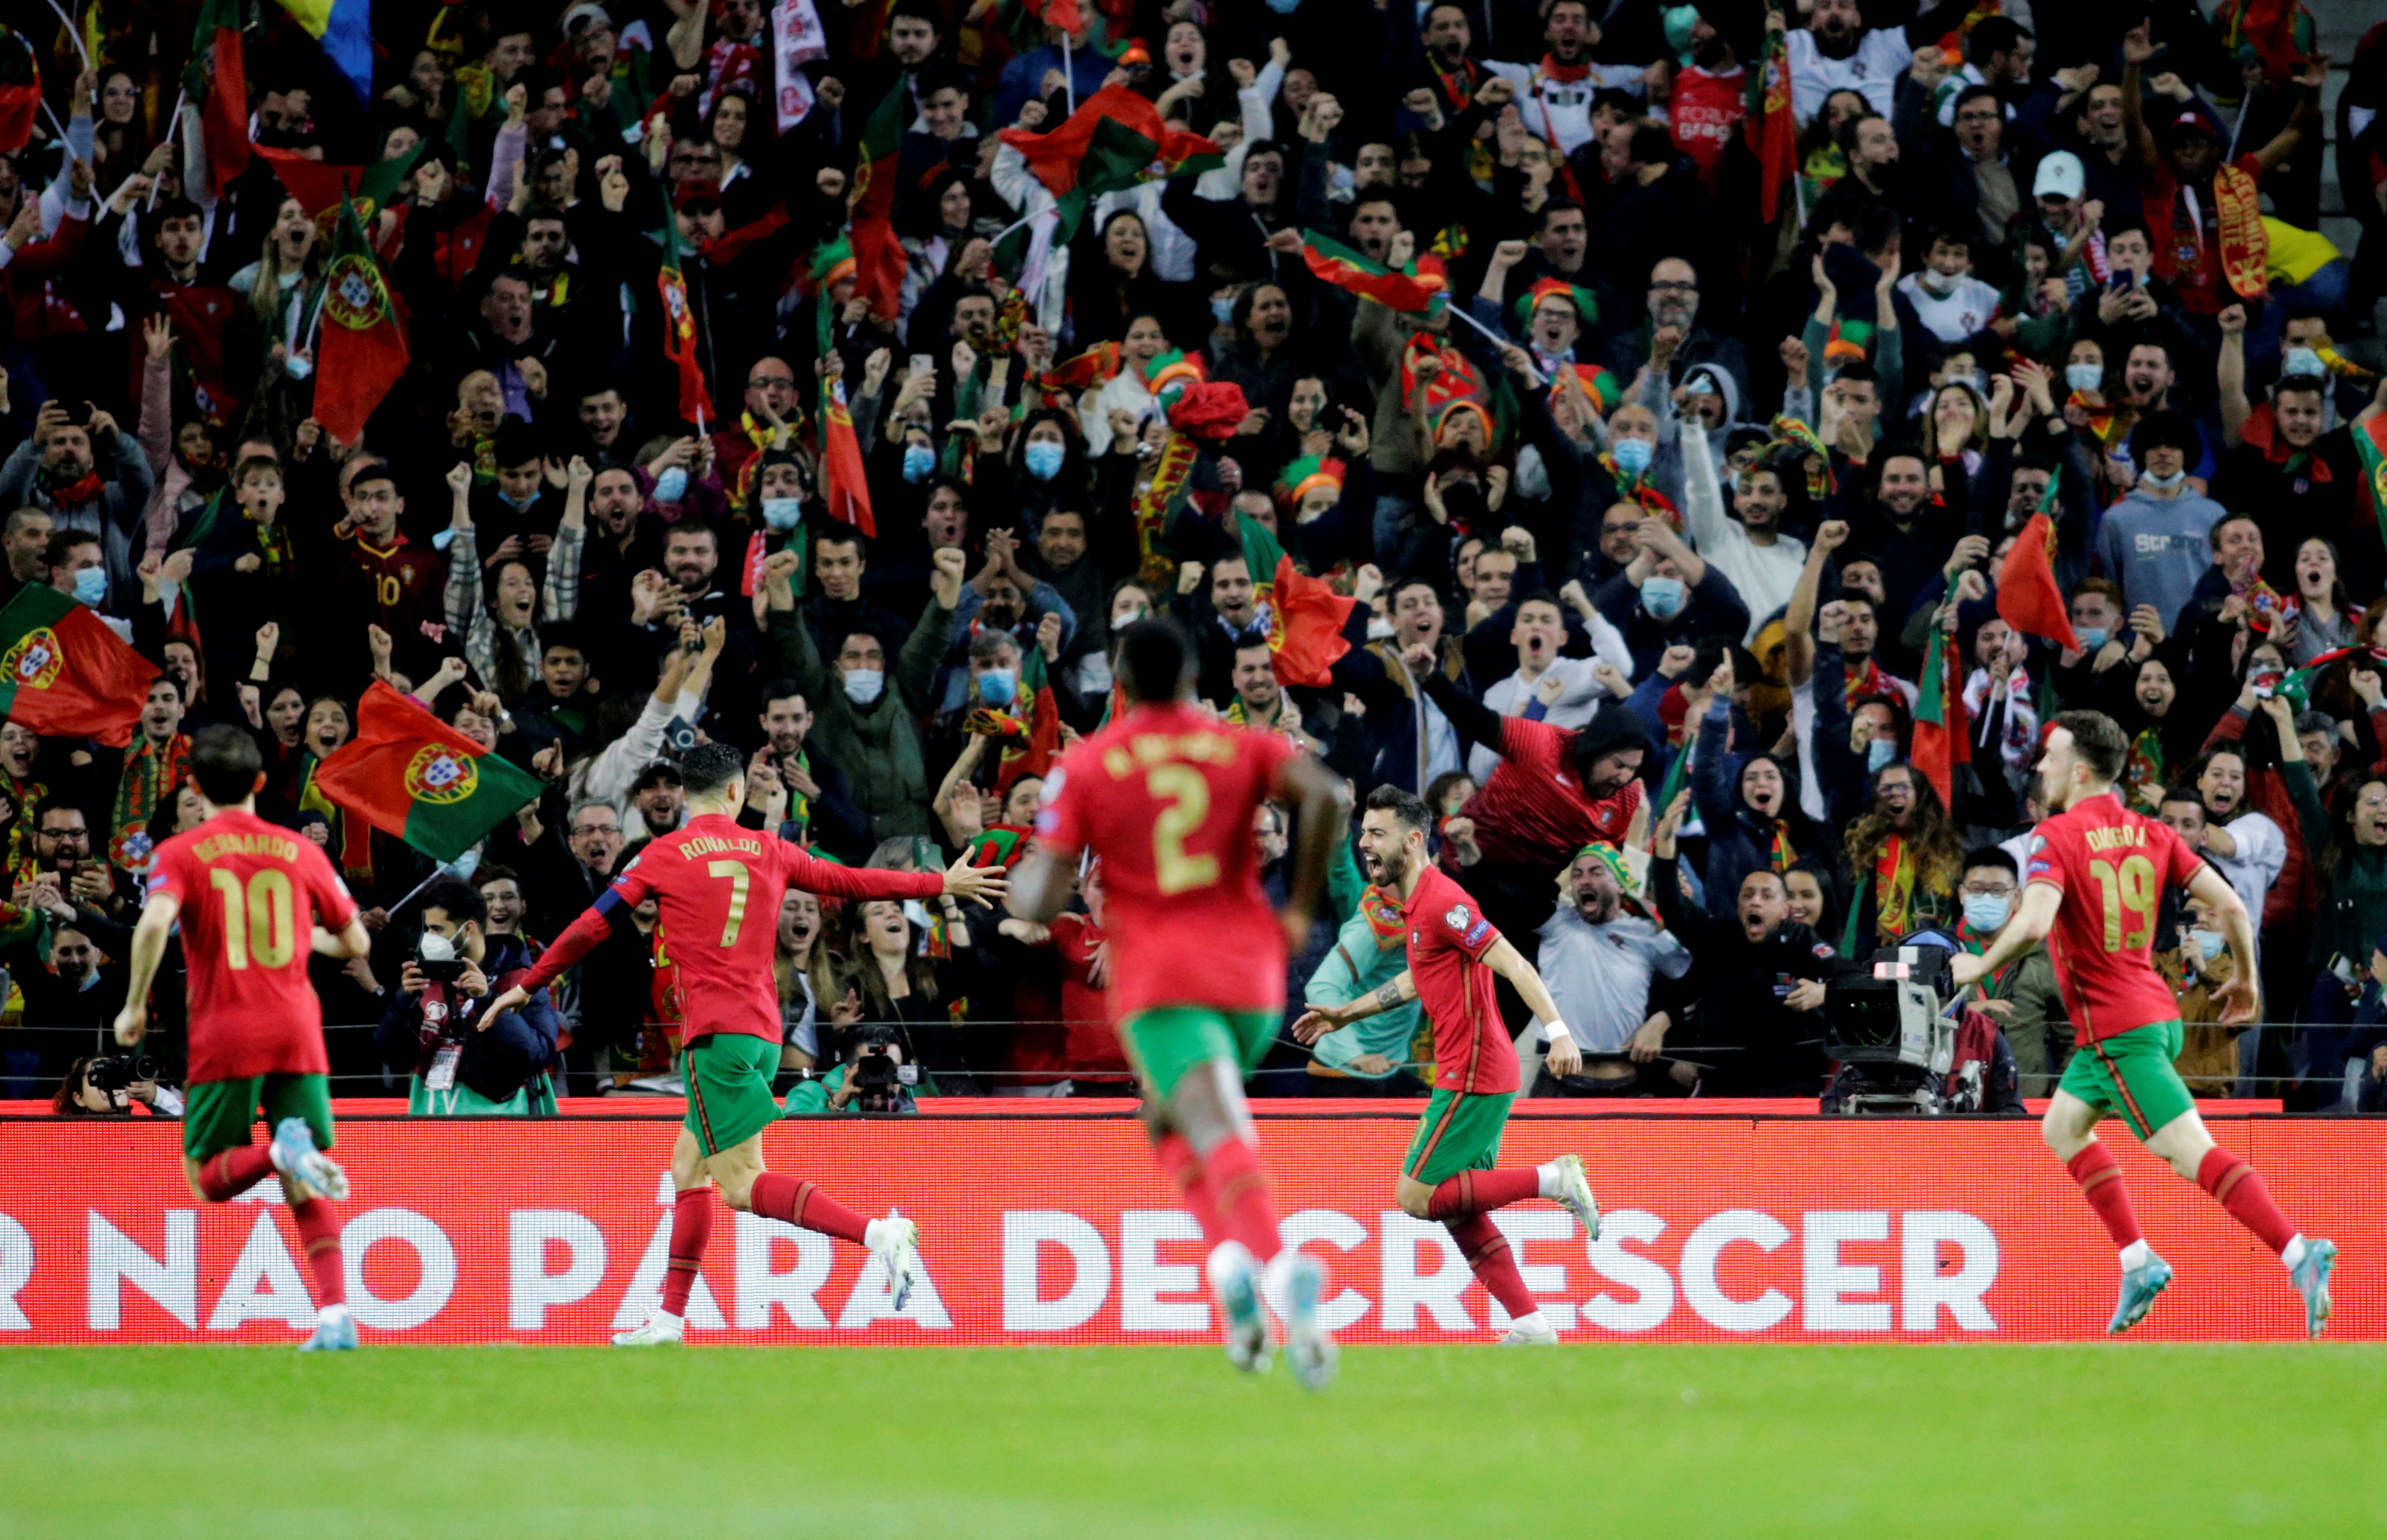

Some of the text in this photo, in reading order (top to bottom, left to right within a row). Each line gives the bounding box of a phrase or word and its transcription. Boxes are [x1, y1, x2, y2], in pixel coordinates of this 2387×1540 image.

[376, 573, 400, 606] 10
[192, 833, 299, 865] BERNARDO
[678, 836, 762, 861] RONALDO
[1146, 763, 1221, 897] 2
[210, 867, 294, 970] 10
[707, 860, 750, 948] 7
[2089, 855, 2155, 952] 19
[88, 1177, 459, 1329] NÃO
[1003, 1209, 1210, 1330] DE
[1261, 1209, 2000, 1331] CRESCER
